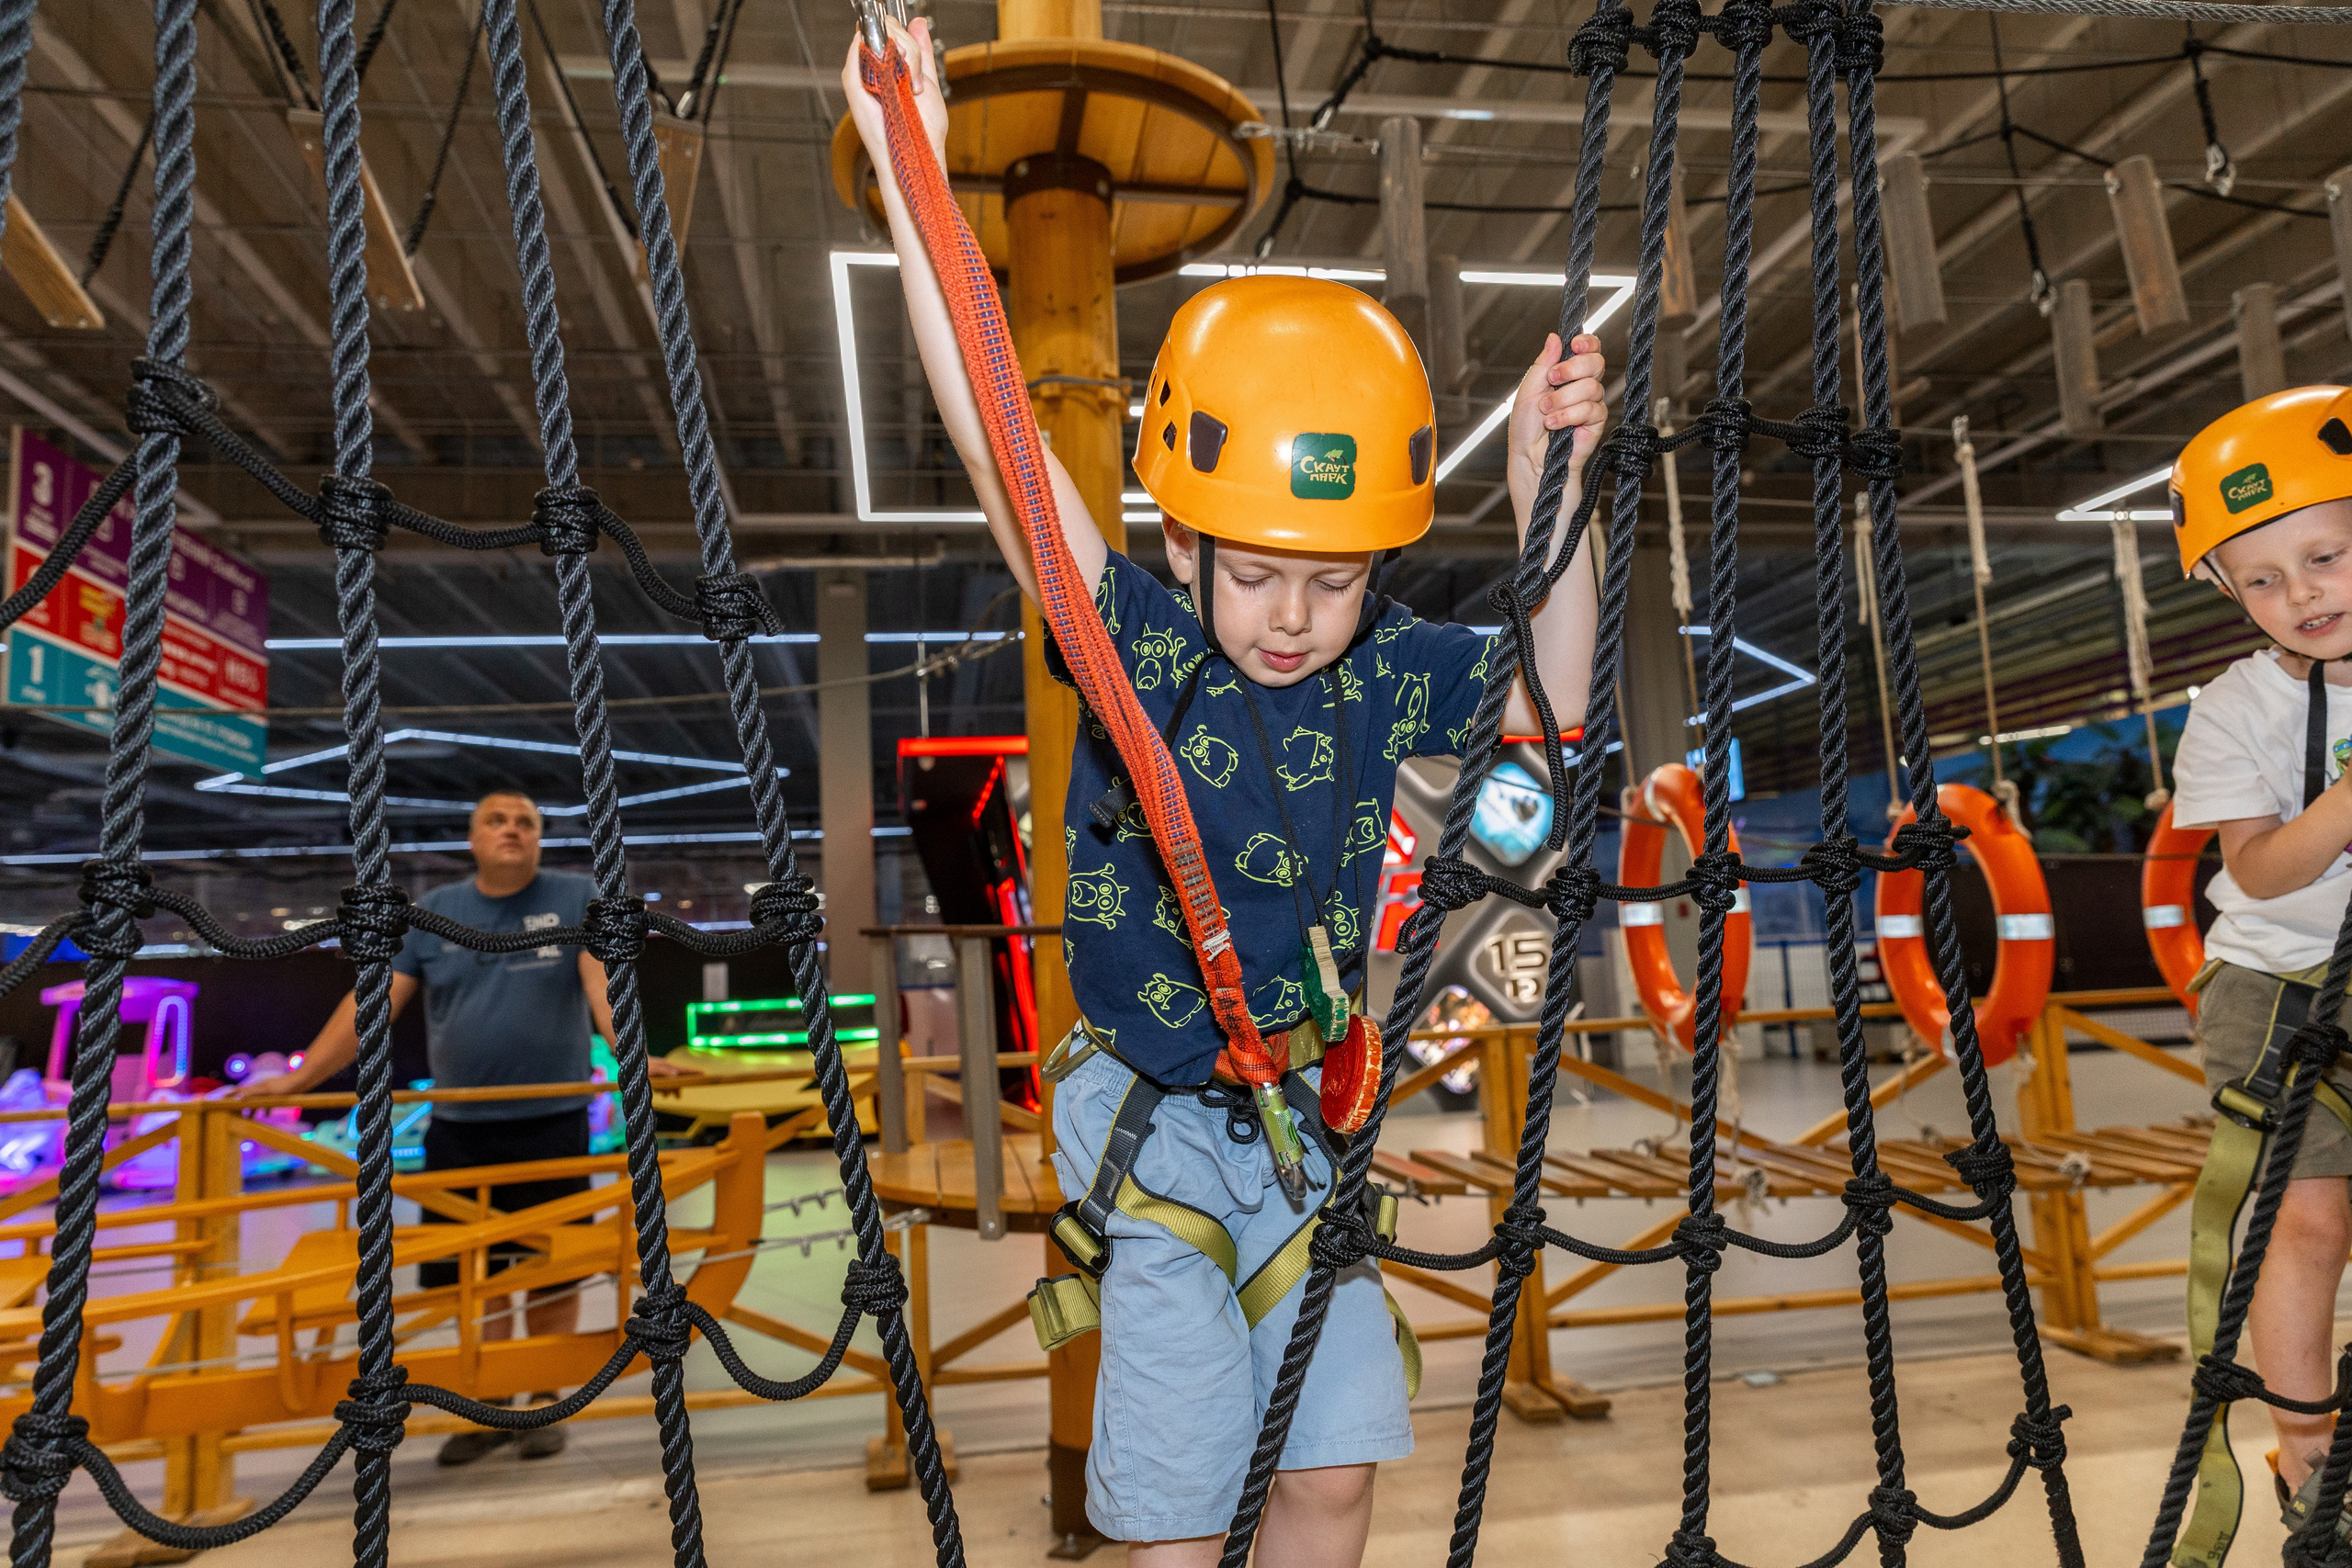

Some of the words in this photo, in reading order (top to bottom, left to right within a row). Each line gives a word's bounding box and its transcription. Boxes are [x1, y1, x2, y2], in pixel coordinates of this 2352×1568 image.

[1300, 456, 1351, 474] СКАУТ
[1309, 472, 1348, 485] ПАРК
[1485, 931, 1547, 976] 15
